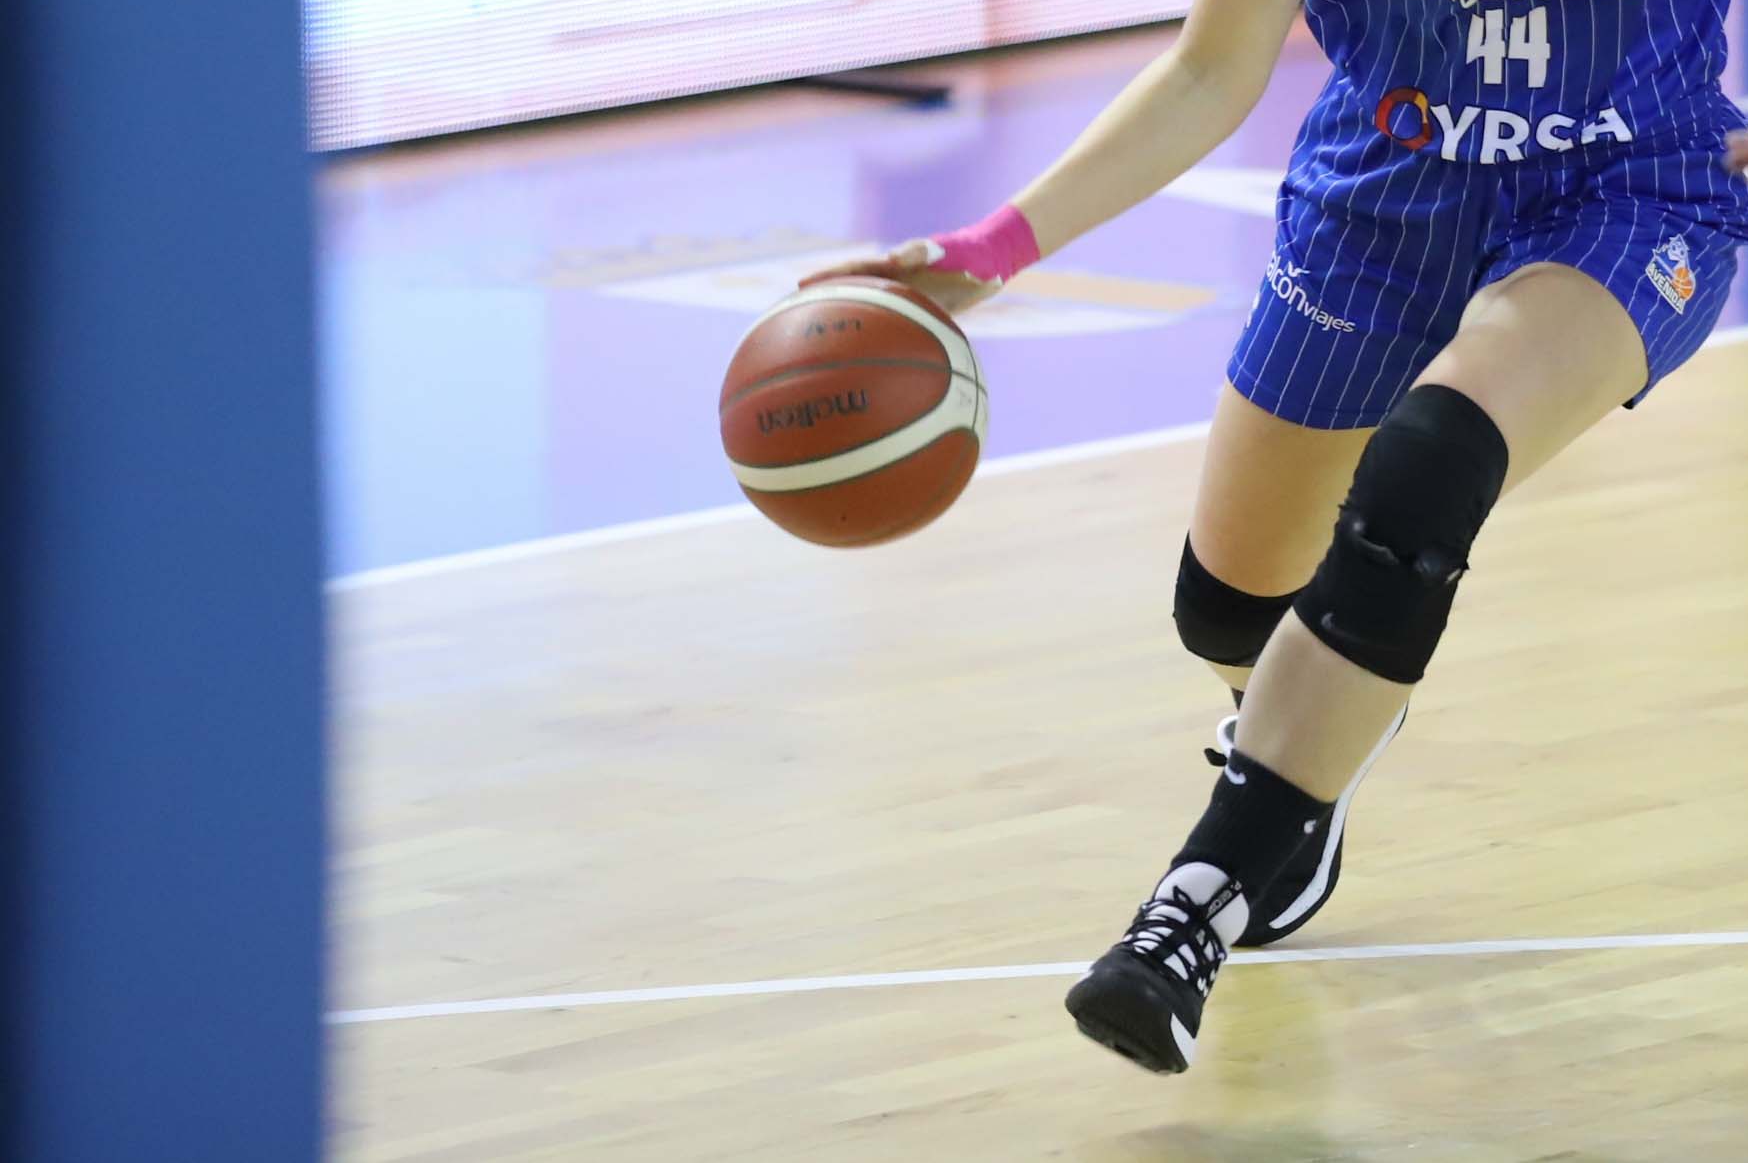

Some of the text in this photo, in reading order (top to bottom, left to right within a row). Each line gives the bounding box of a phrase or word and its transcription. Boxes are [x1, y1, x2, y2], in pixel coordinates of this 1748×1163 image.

[1466, 5, 1551, 87] 44
[1646, 261, 1685, 312] AVENIDA
[1304, 301, 1356, 333] viajes
